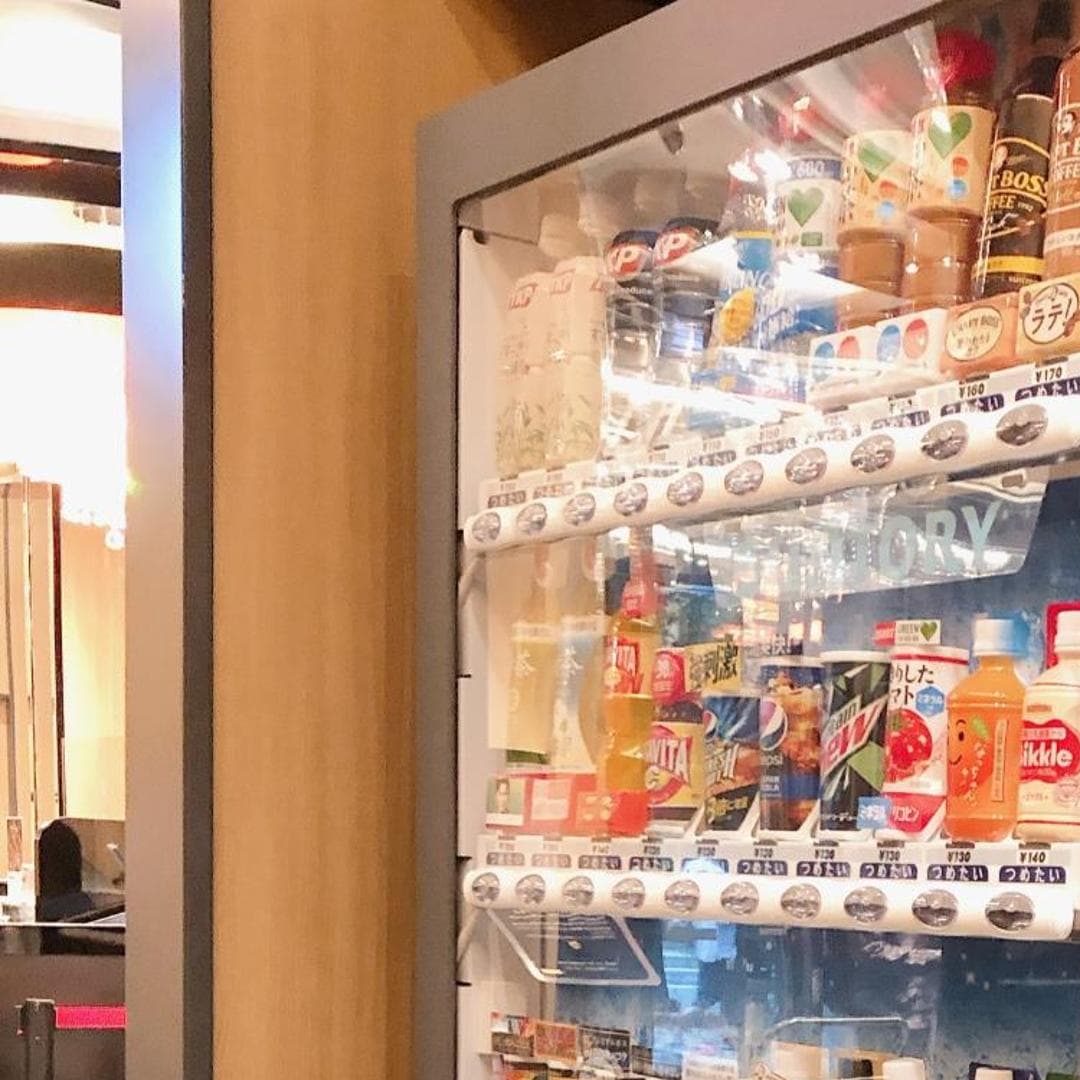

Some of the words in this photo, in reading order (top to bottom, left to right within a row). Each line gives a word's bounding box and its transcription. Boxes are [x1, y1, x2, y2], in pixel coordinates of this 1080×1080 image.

[879, 850, 900, 861] ¥130
[948, 851, 971, 863] ¥130
[1020, 852, 1046, 863] ¥140
[930, 865, 986, 881] つめたい
[1003, 866, 1063, 883] つめたい
